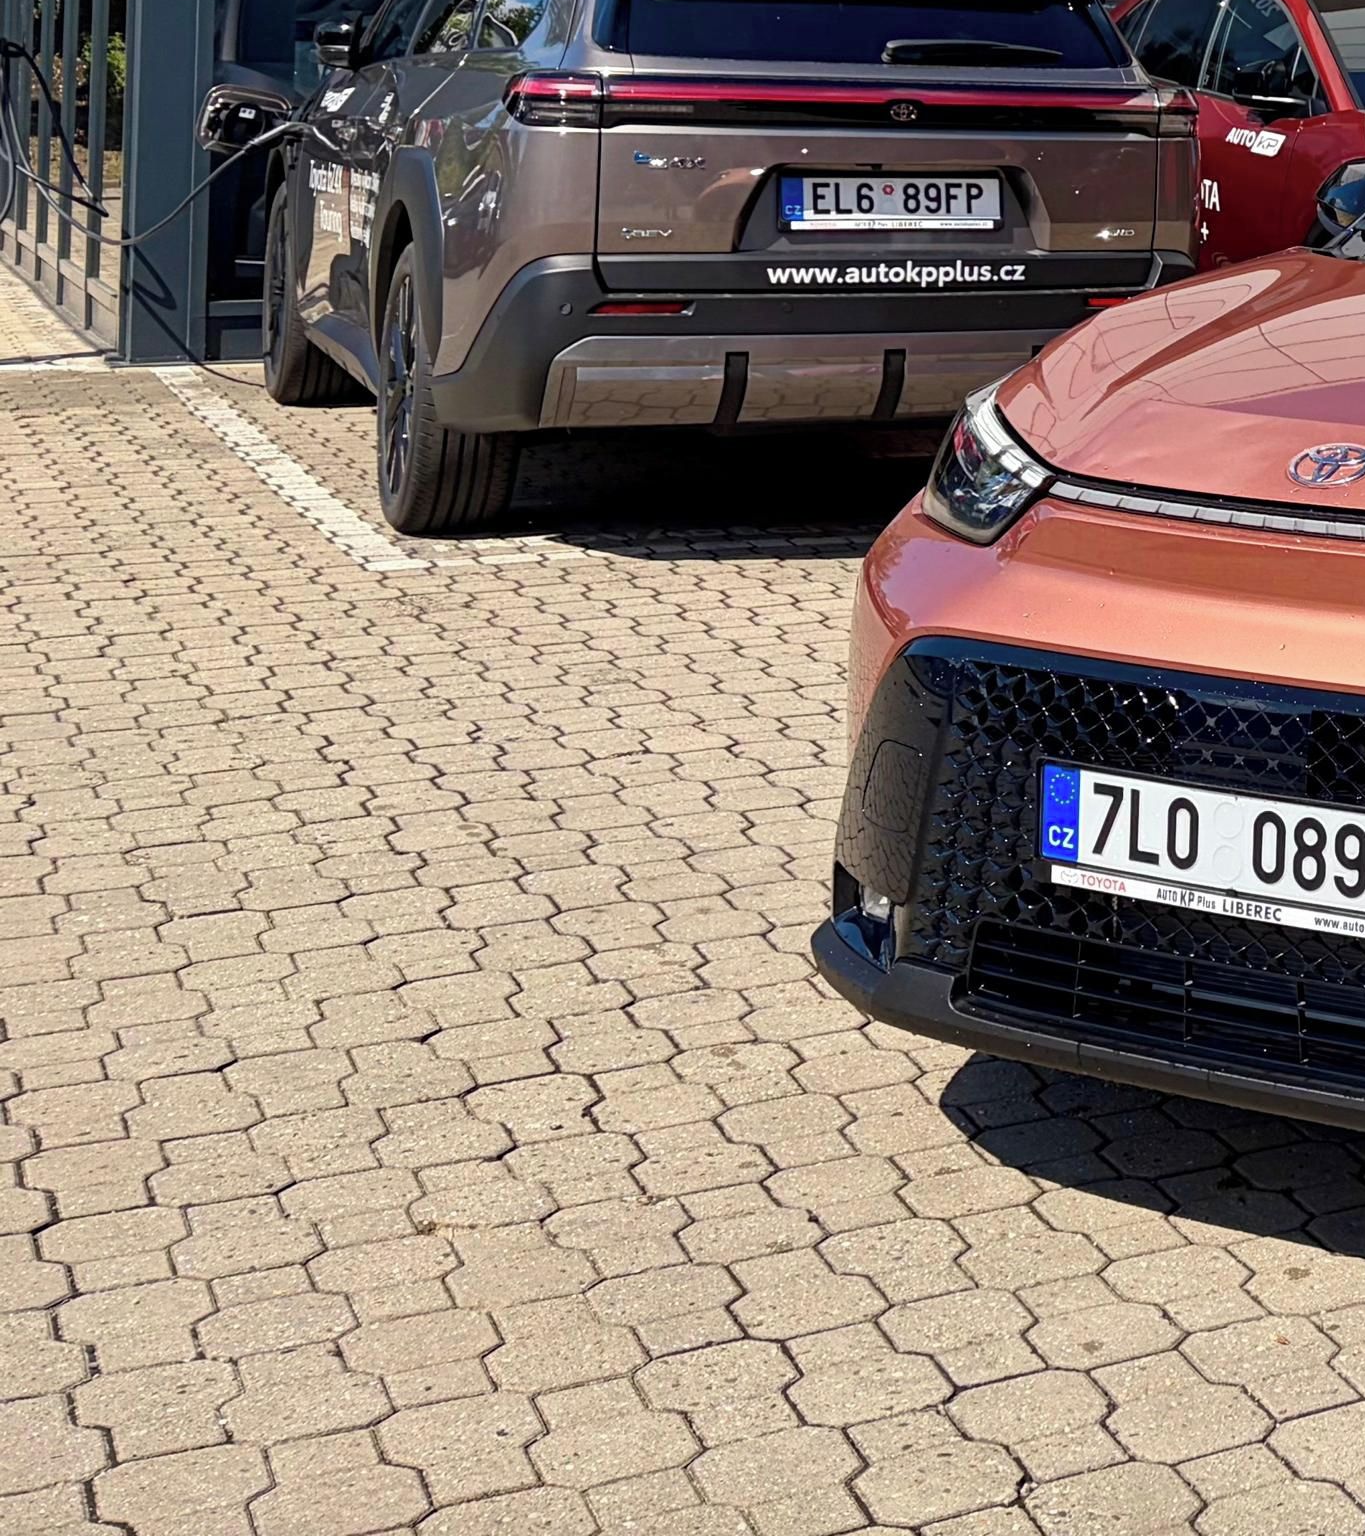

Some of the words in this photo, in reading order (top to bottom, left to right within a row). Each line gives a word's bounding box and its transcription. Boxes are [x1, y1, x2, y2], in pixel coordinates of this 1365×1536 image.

[1225, 127, 1257, 148] AUTO
[785, 205, 801, 215] CZ
[812, 182, 875, 214] EL6
[902, 182, 984, 214] 89FP
[767, 261, 1026, 288] www.autokpplus.cz
[1048, 825, 1074, 849] CZ
[1092, 782, 1199, 870] 7L0
[1081, 874, 1126, 893] TOYOTA
[1156, 887, 1178, 902] AUTO
[1180, 890, 1195, 908] KP
[1197, 895, 1216, 910] Plus
[1222, 898, 1283, 922] LIBEREC
